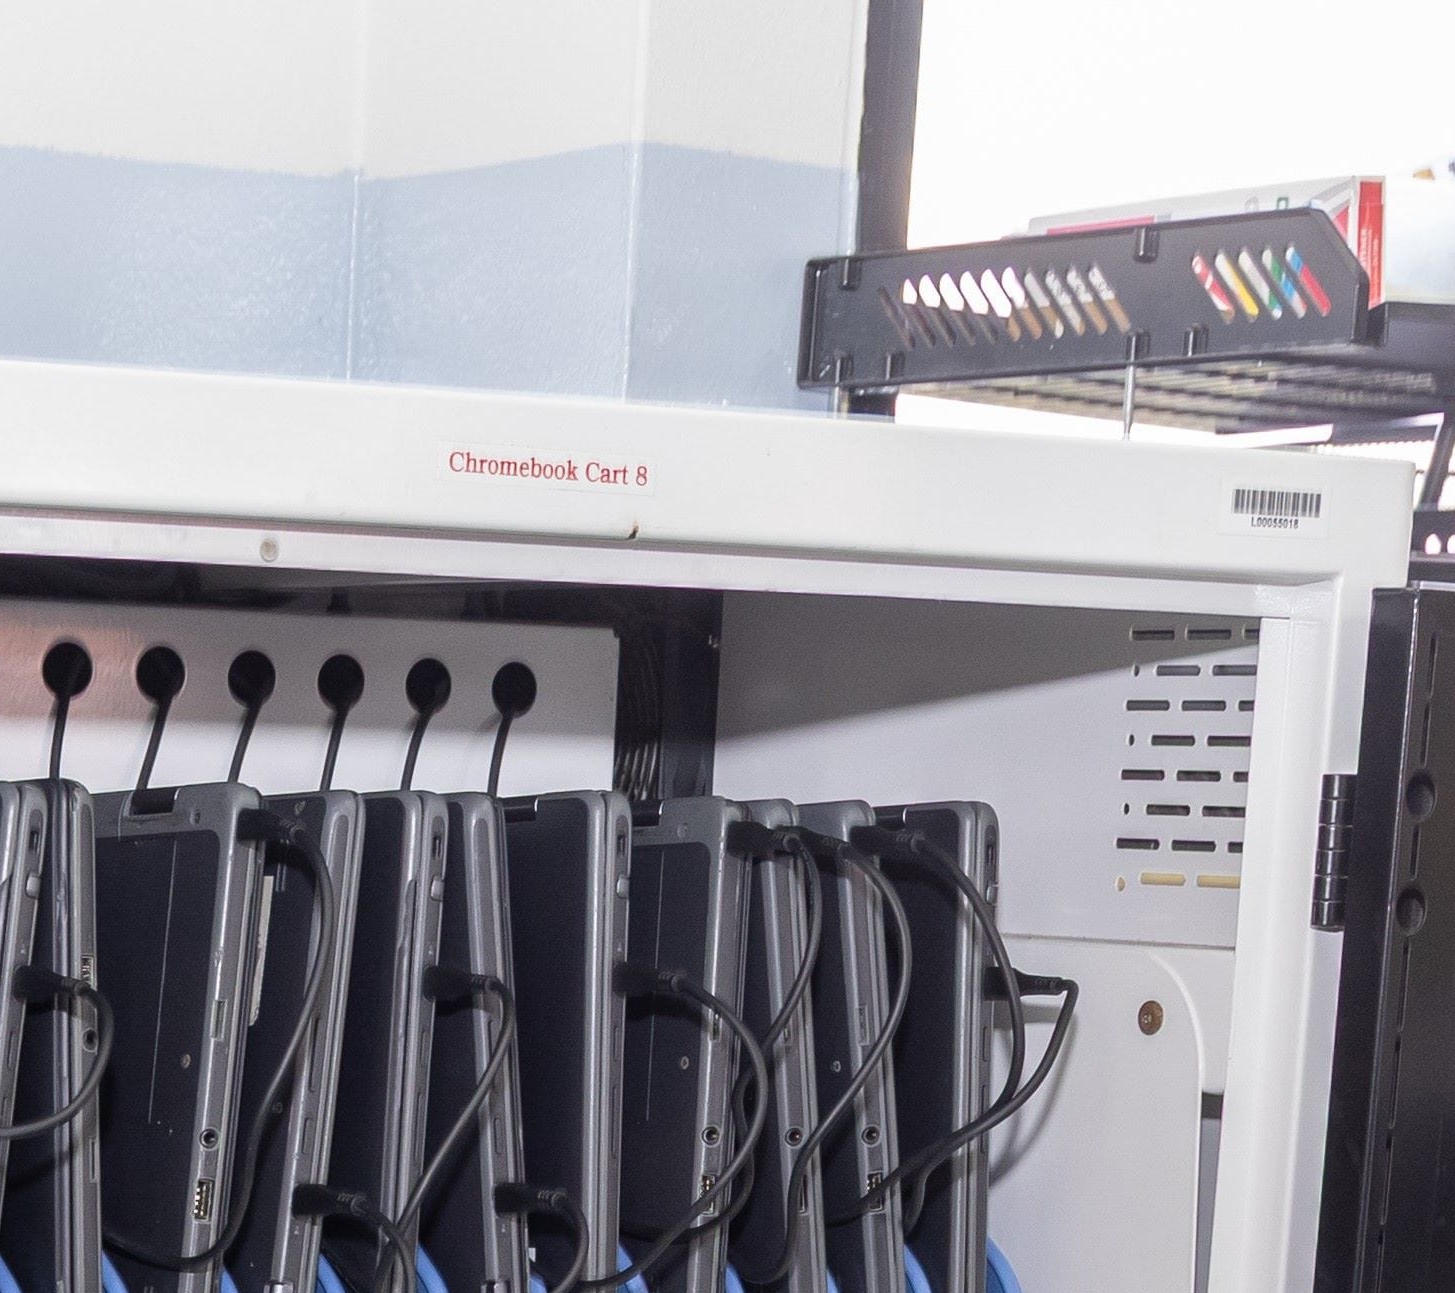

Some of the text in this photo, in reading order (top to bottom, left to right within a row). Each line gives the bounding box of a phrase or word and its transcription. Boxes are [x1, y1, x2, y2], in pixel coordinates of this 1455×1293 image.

[449, 451, 648, 486] Chromebook Cart 8
